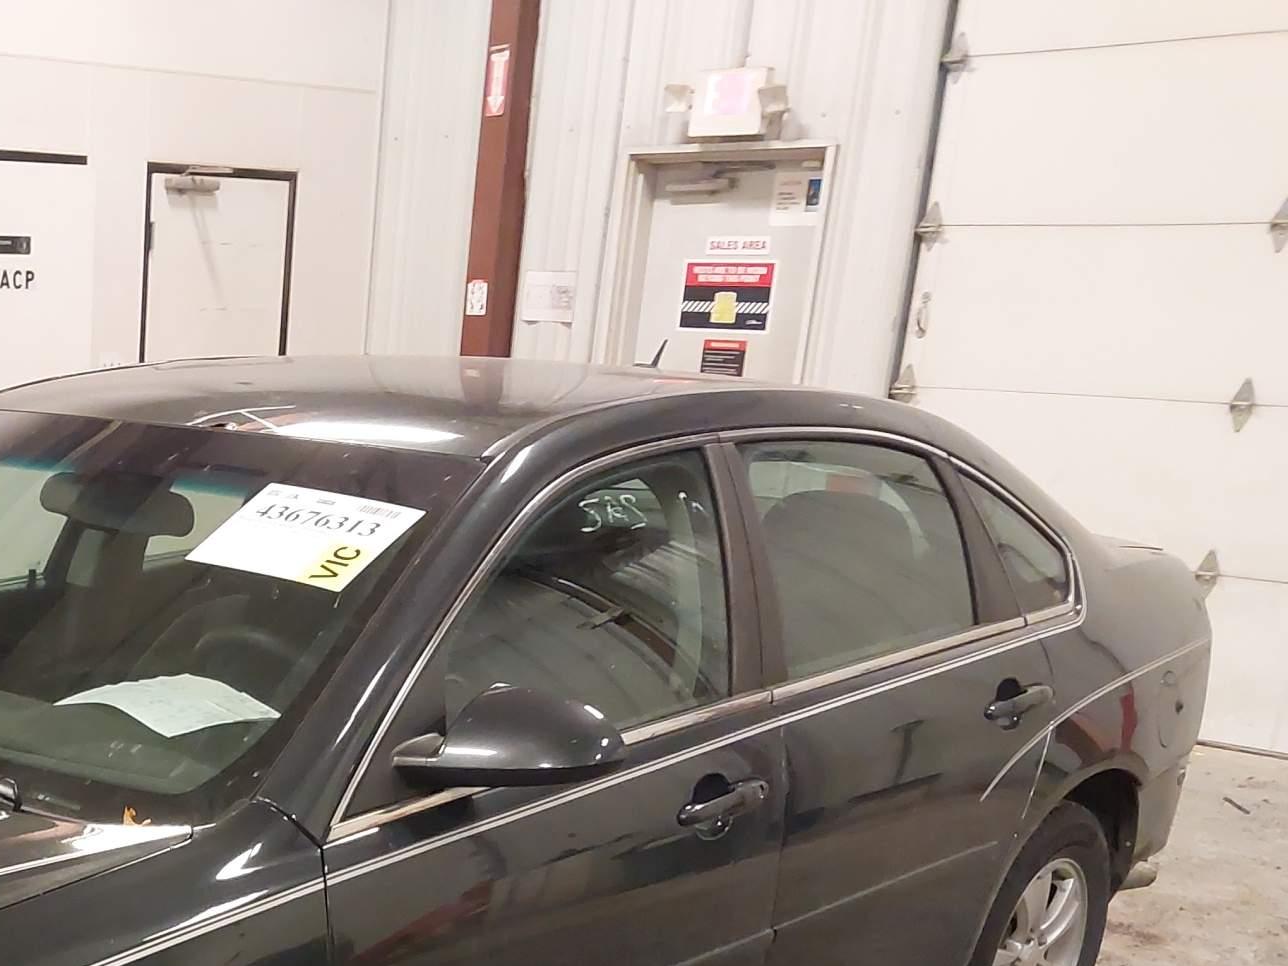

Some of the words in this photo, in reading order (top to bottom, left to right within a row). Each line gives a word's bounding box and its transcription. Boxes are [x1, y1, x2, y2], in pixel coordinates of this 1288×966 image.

[709, 240, 739, 250] SALES
[742, 240, 767, 249] AREA
[255, 503, 382, 537] 43676313
[308, 546, 362, 580] VIC
